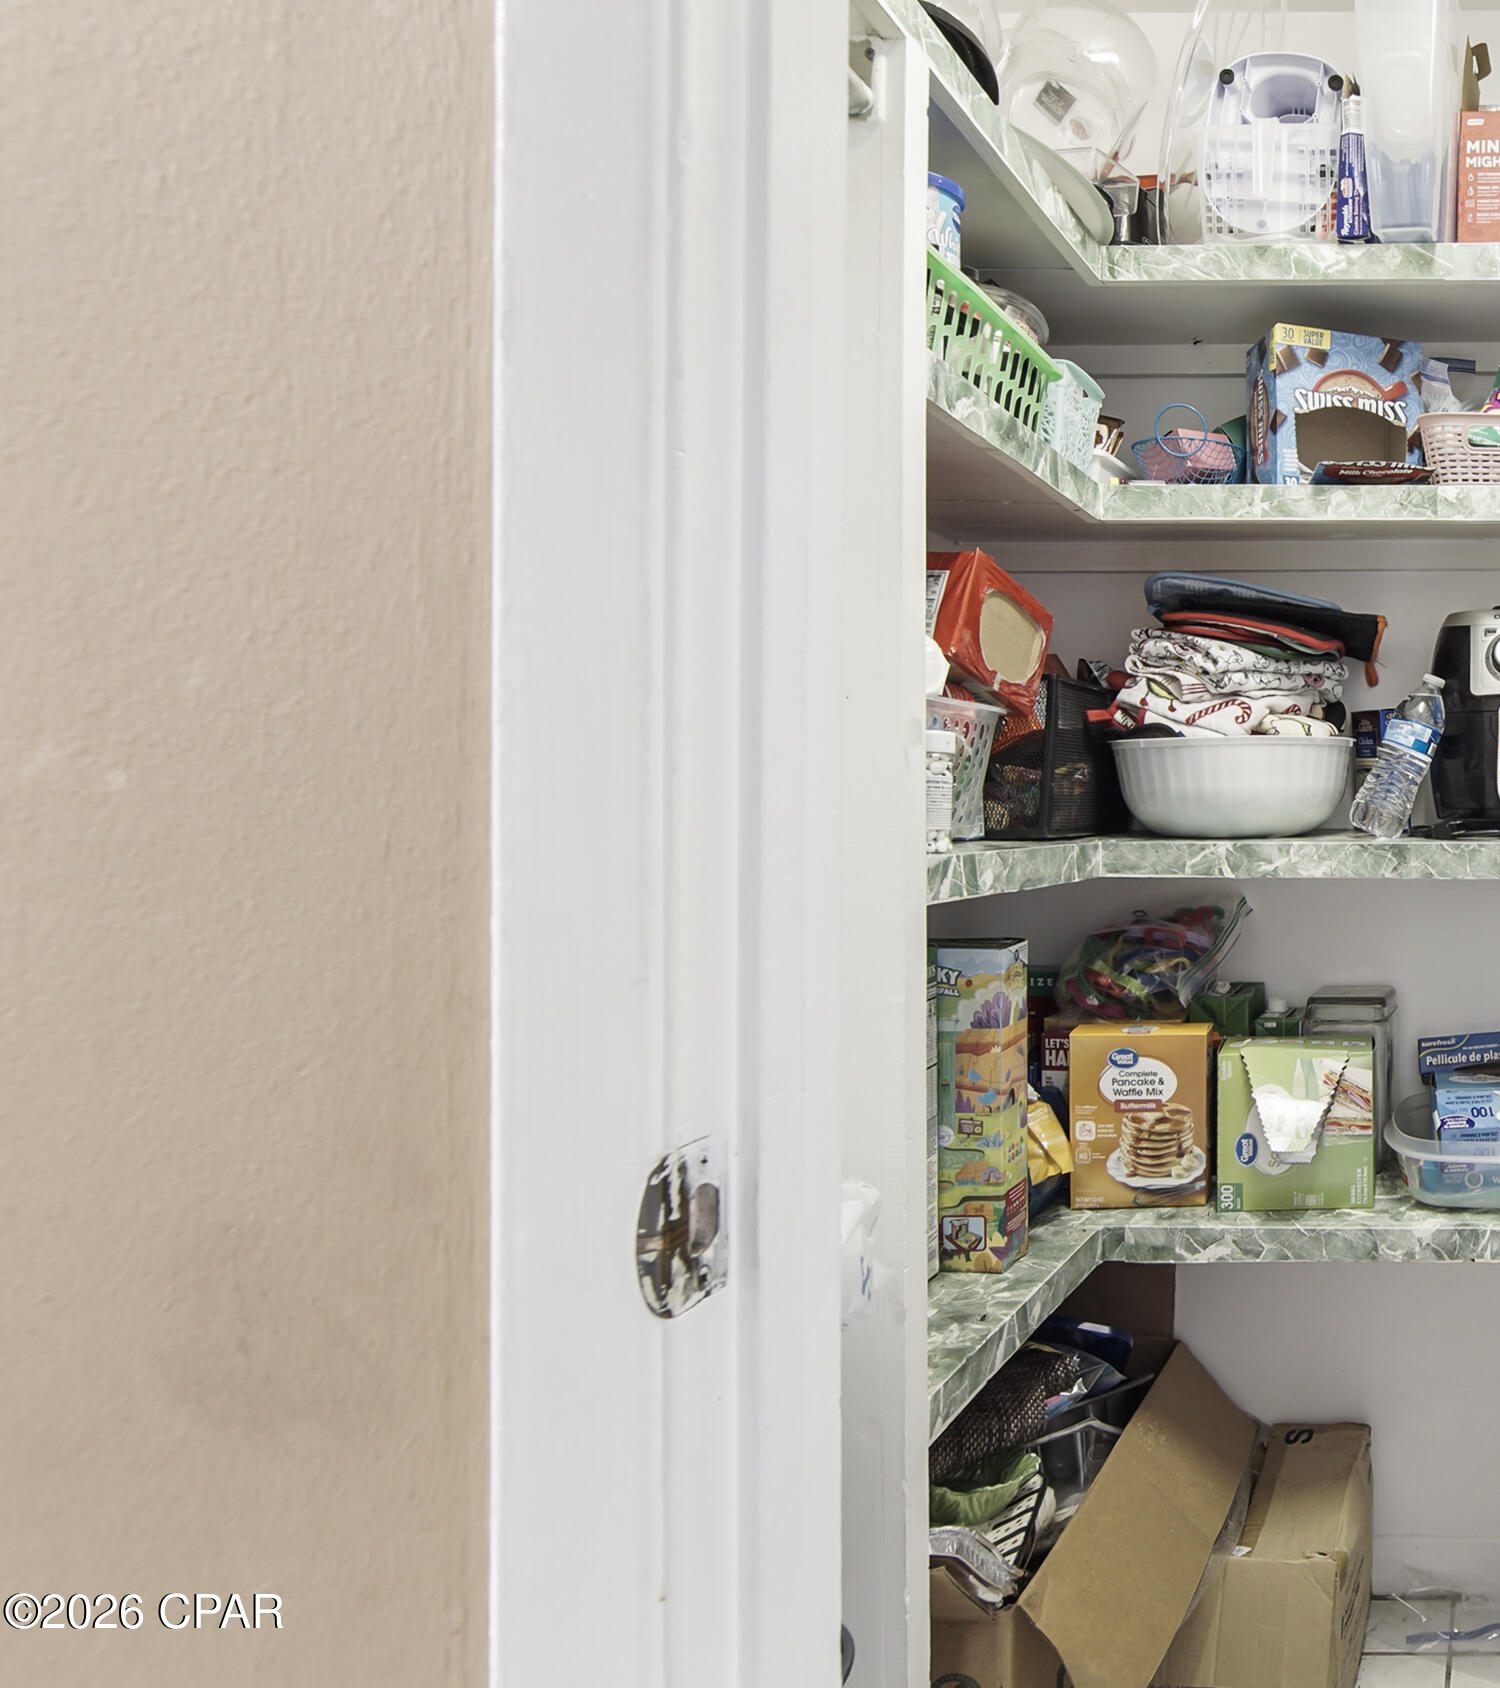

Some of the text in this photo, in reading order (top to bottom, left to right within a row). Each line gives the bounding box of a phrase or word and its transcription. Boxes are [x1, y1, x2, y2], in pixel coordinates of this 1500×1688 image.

[1282, 328, 1294, 339] 30
[1304, 329, 1324, 338] SUPER
[1304, 337, 1323, 346] VALUE
[1362, 468, 1414, 476] Chocolate
[938, 968, 960, 985] KY
[1045, 1039, 1069, 1048] LET'S
[1111, 1053, 1133, 1061] Great
[1426, 1052, 1467, 1066] Pellicule
[1469, 1051, 1482, 1063] de
[1112, 1078, 1155, 1086] Pancake
[1113, 1088, 1143, 1096] Waffle
[1471, 1107, 1494, 1118] 100
[1240, 1139, 1249, 1162] Great
[1221, 1185, 1233, 1210] 300
[1284, 1428, 1314, 1445] S
